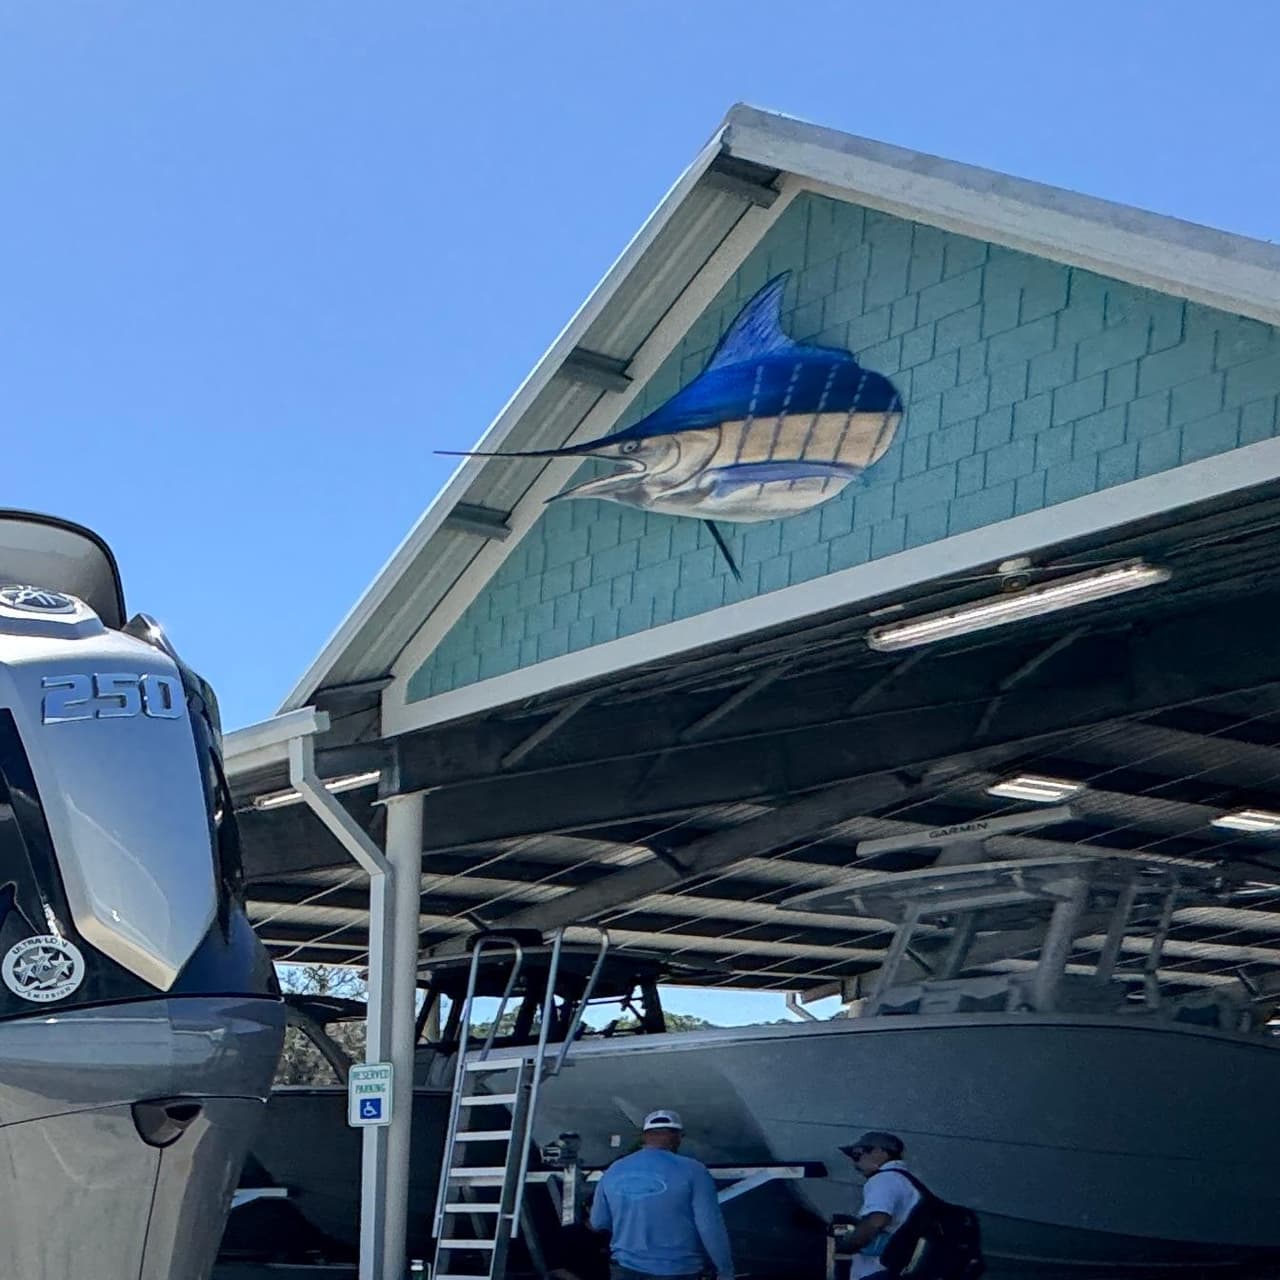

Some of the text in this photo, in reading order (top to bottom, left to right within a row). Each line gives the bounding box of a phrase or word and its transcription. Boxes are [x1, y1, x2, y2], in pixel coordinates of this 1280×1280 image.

[41, 672, 187, 725] 250
[929, 822, 988, 838] GARMIN
[12, 937, 42, 955] ULTRA
[351, 1069, 390, 1081] RESERVED
[355, 1083, 385, 1094] PARKING
